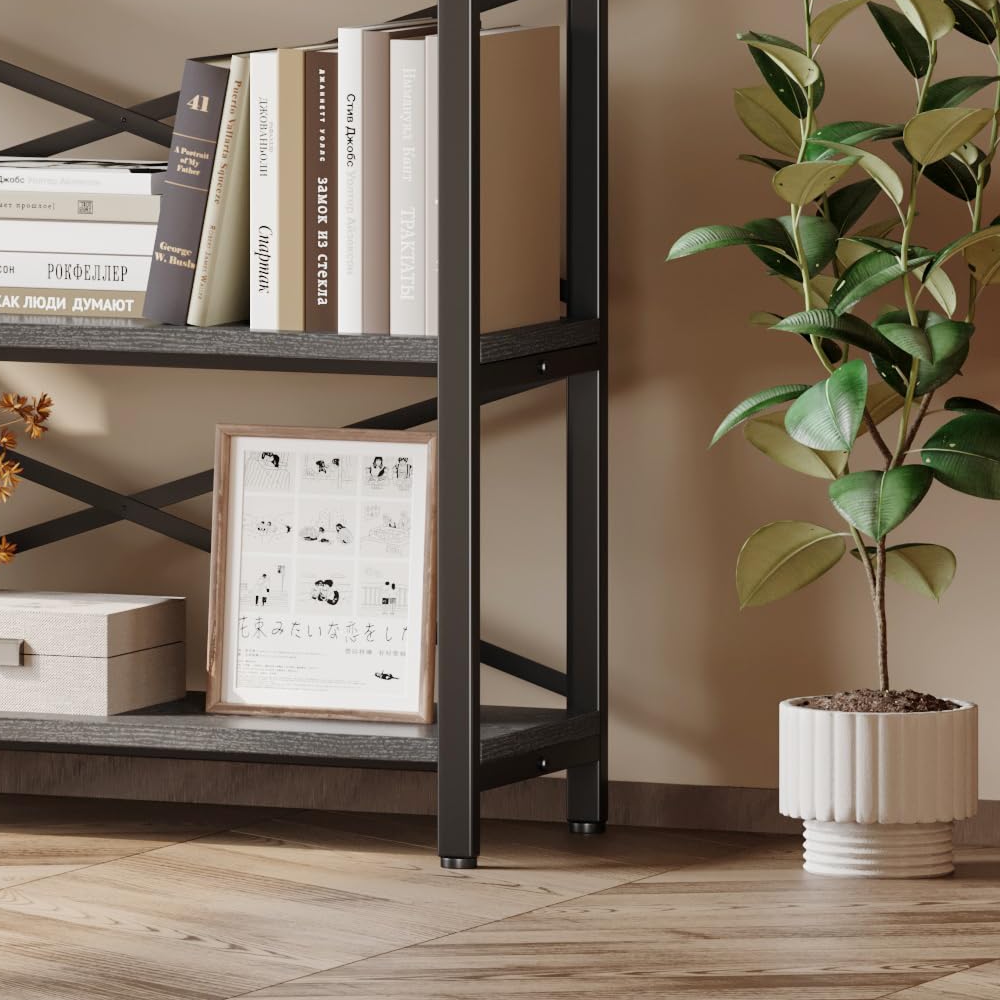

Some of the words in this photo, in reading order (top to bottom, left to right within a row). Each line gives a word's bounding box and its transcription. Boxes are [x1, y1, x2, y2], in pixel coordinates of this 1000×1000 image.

[187, 95, 209, 113] 41
[230, 80, 243, 118] Puerto
[346, 93, 356, 124] Стив
[222, 119, 236, 160] Vallarta
[259, 97, 268, 177] ДЖОВАНЬОЛИ
[318, 128, 326, 162] УОЛЛС
[345, 126, 356, 167] Джобс
[180, 157, 189, 165] of
[188, 158, 199, 168] My
[181, 147, 209, 160] Portrait
[176, 165, 201, 176] Father
[214, 163, 227, 205] Squeeze
[154, 251, 167, 263] W.
[159, 241, 192, 257] George
[254, 225, 273, 294] Спартак
[400, 208, 416, 301] ТРАКТАТЫ
[47, 262, 128, 282] РОКФЕЛЛЕР
[23, 295, 66, 310] ЛЮДИ
[72, 297, 134, 312] ДУМАЮТ
